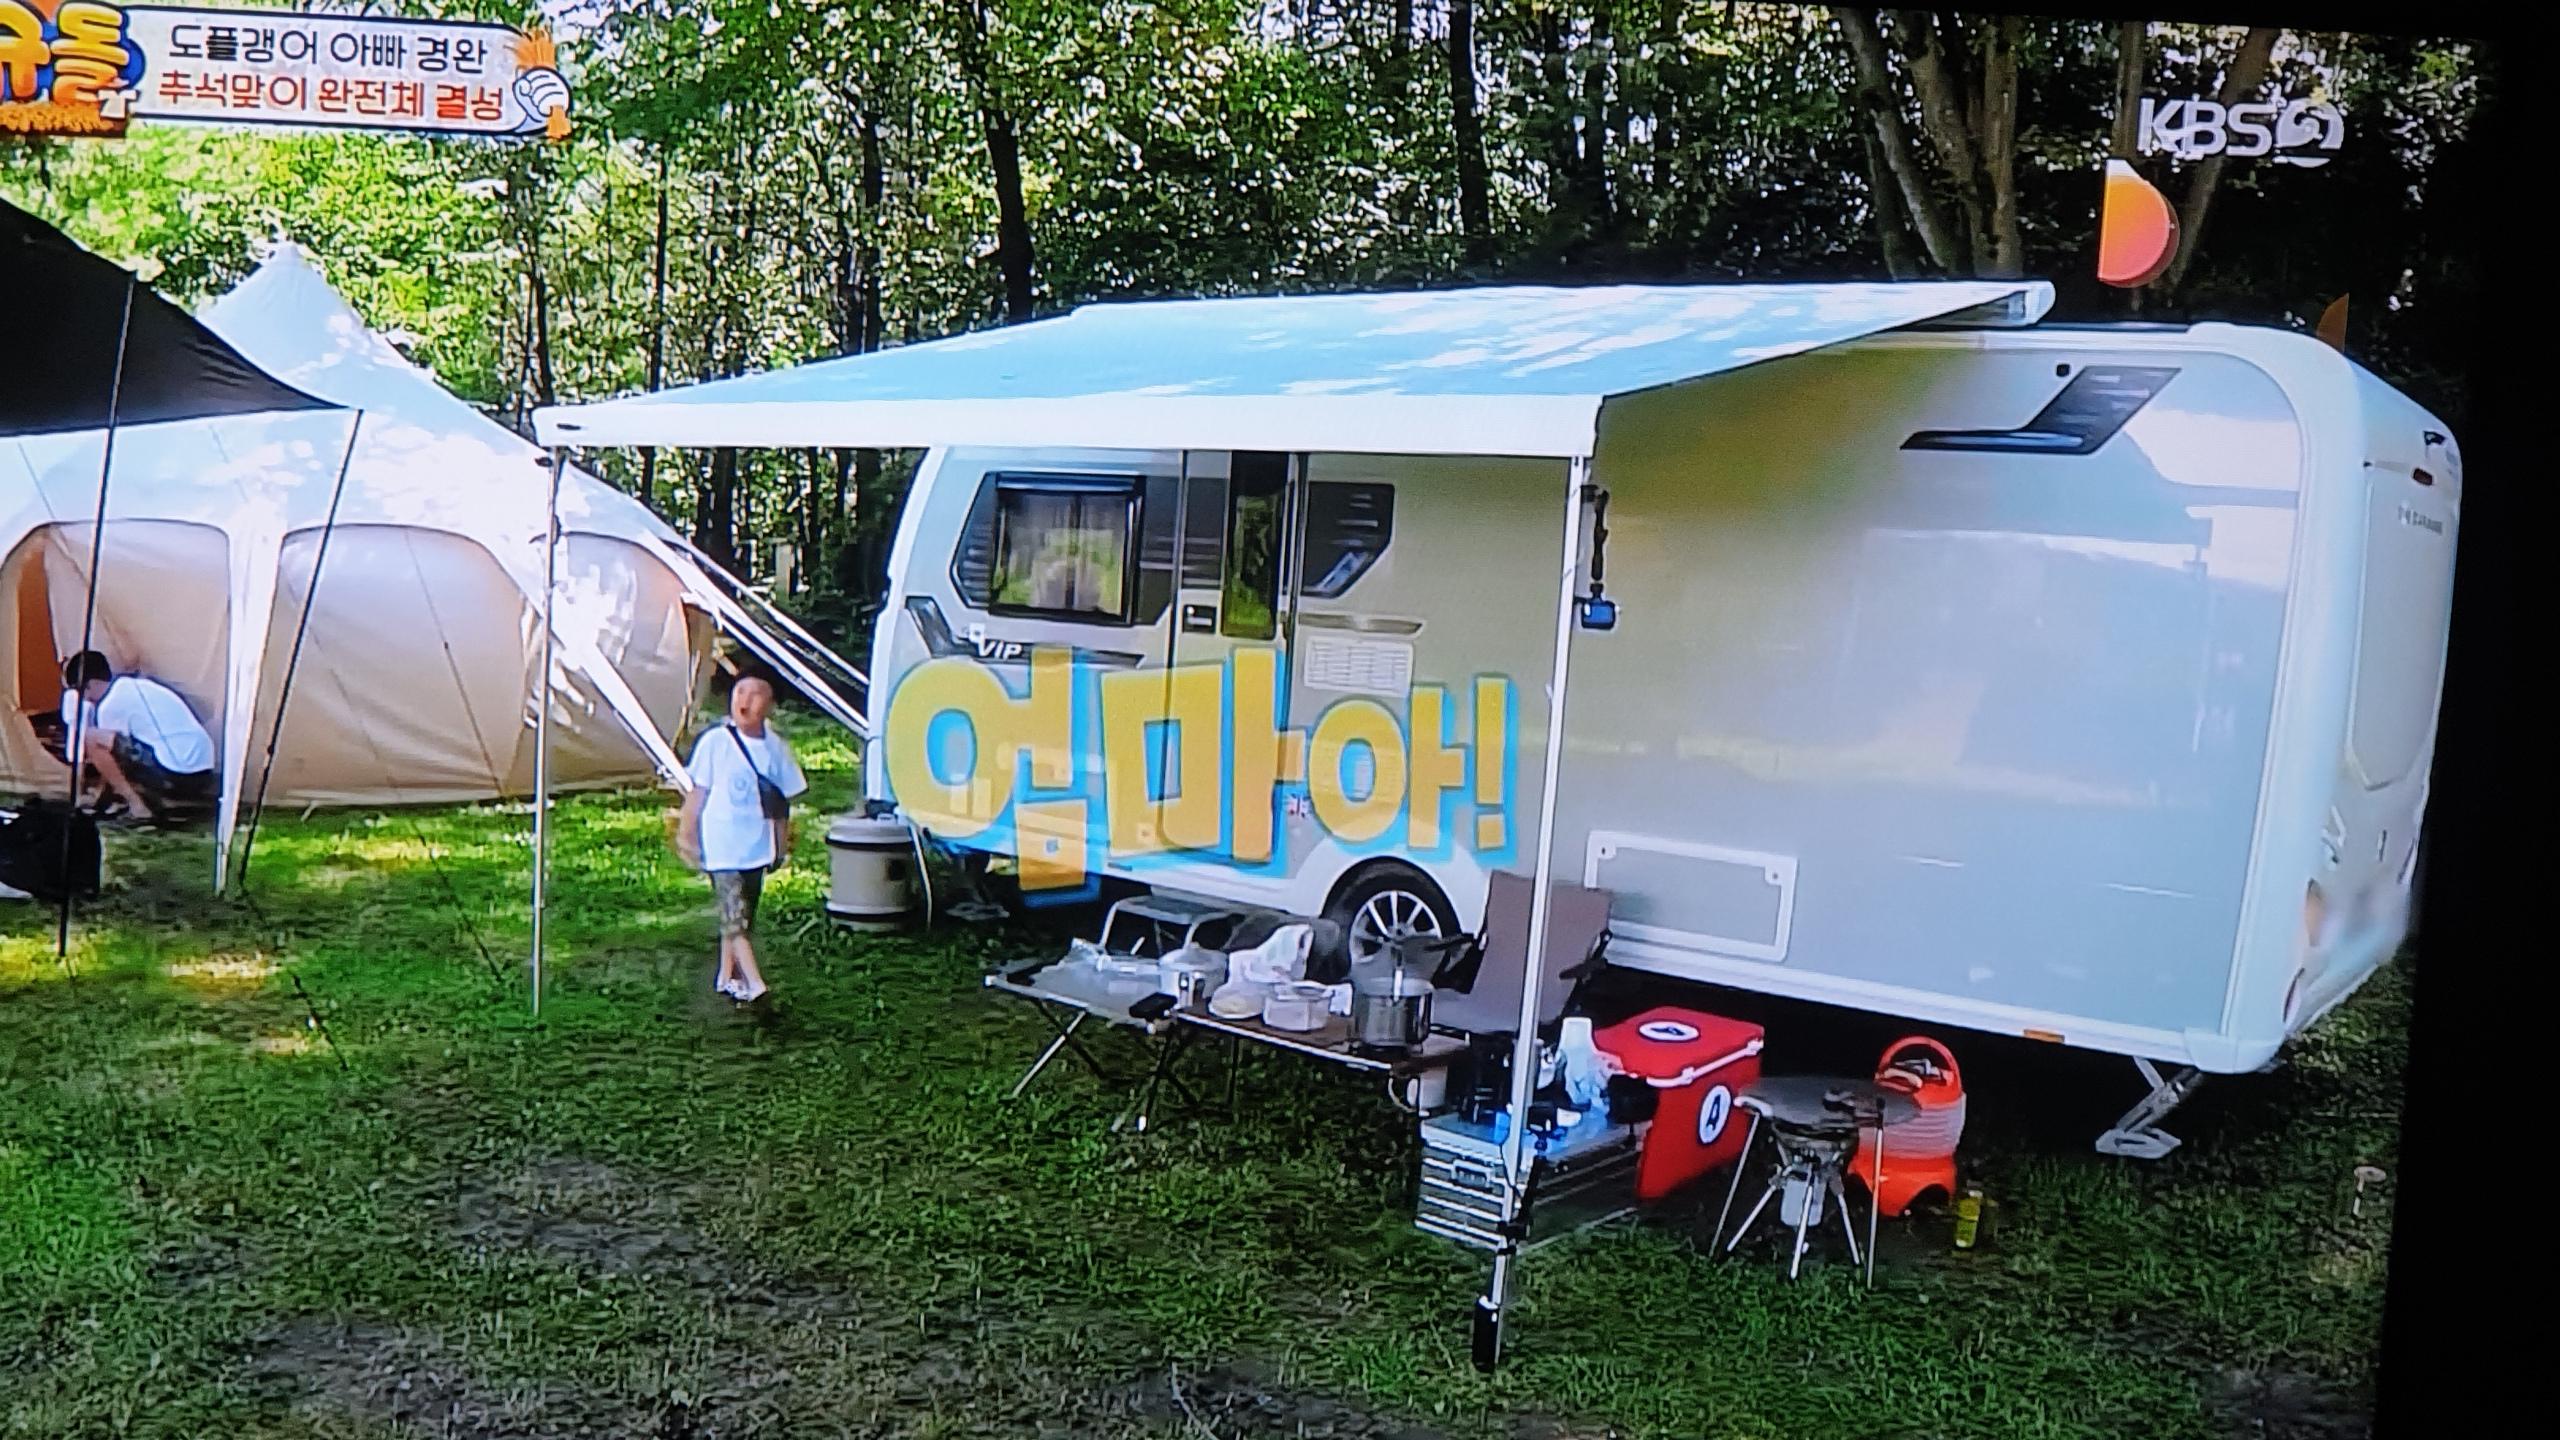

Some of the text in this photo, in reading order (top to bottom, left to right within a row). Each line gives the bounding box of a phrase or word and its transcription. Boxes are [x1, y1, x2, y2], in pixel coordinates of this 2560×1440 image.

[168, 24, 488, 74] 도플갱어 아빠 경완
[159, 69, 503, 121] 추석맞이 완전체 결성
[977, 638, 1023, 661] VIP
[884, 645, 1512, 892] 엄마야!
